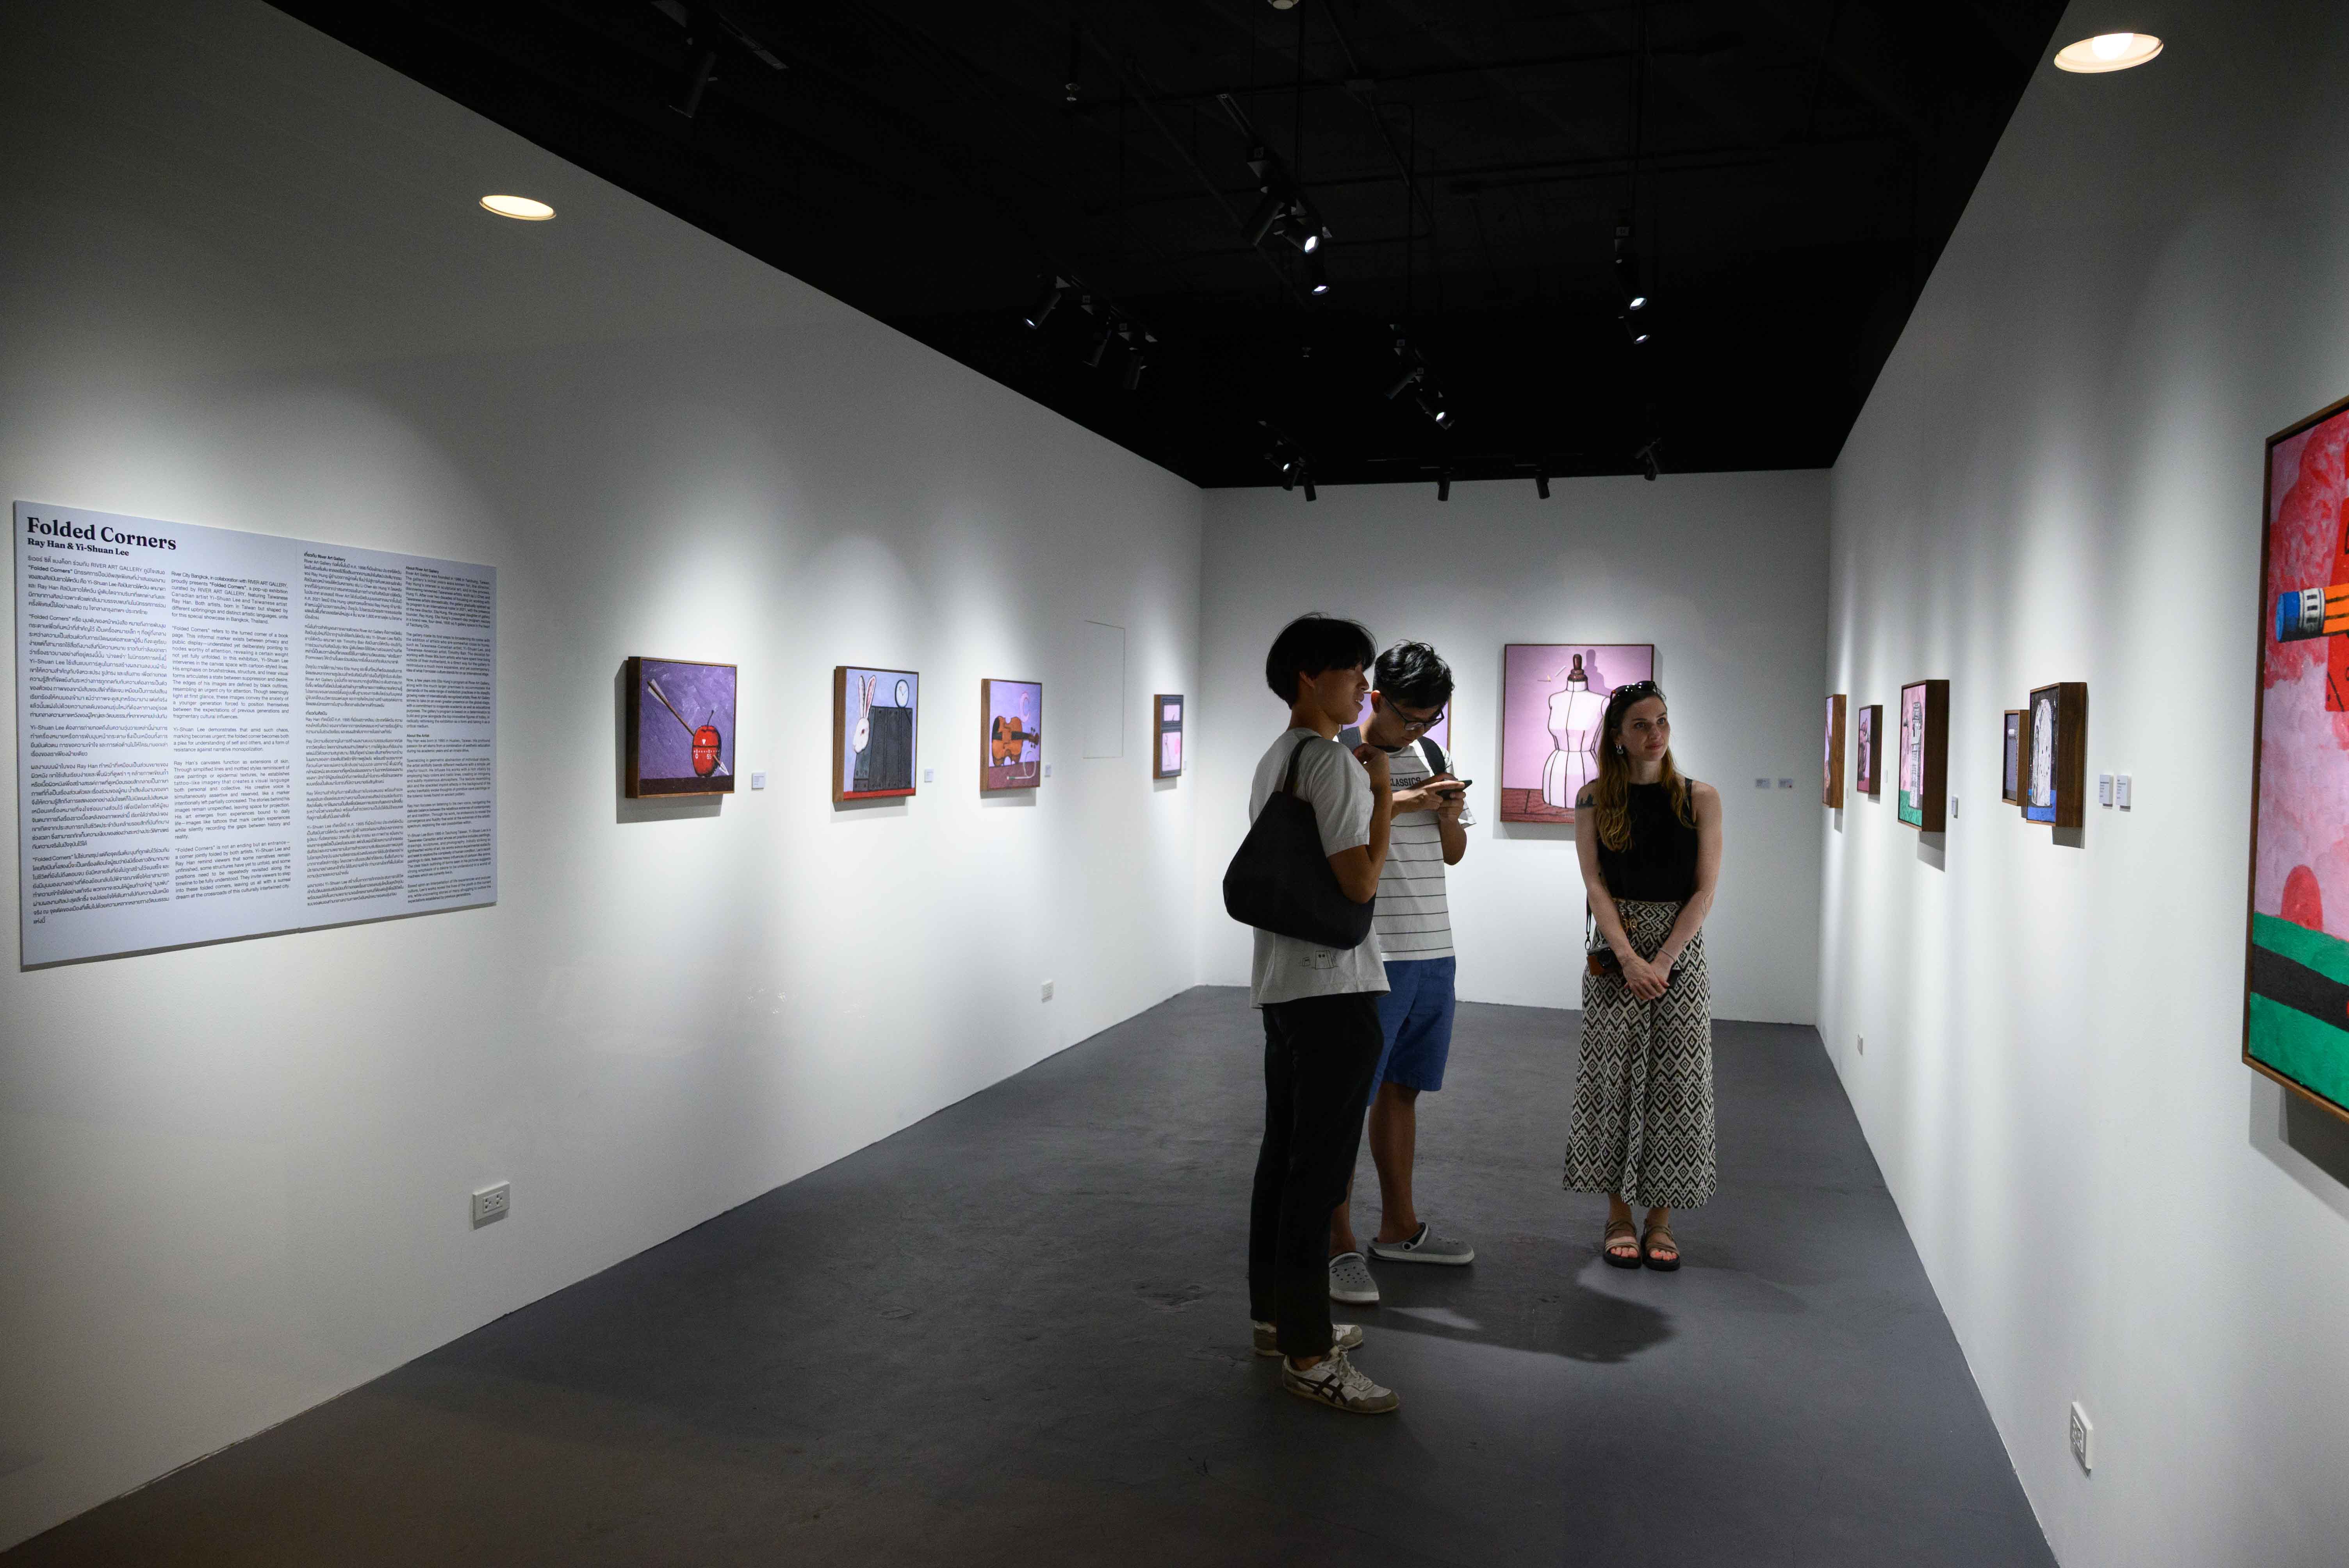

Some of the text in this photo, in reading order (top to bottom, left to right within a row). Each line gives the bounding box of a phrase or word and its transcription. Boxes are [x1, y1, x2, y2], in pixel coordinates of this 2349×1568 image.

[27, 517, 176, 550] Folded Corners
[28, 538, 44, 548] Ray
[47, 540, 65, 549] Han
[75, 543, 113, 554] Yi-Shuan
